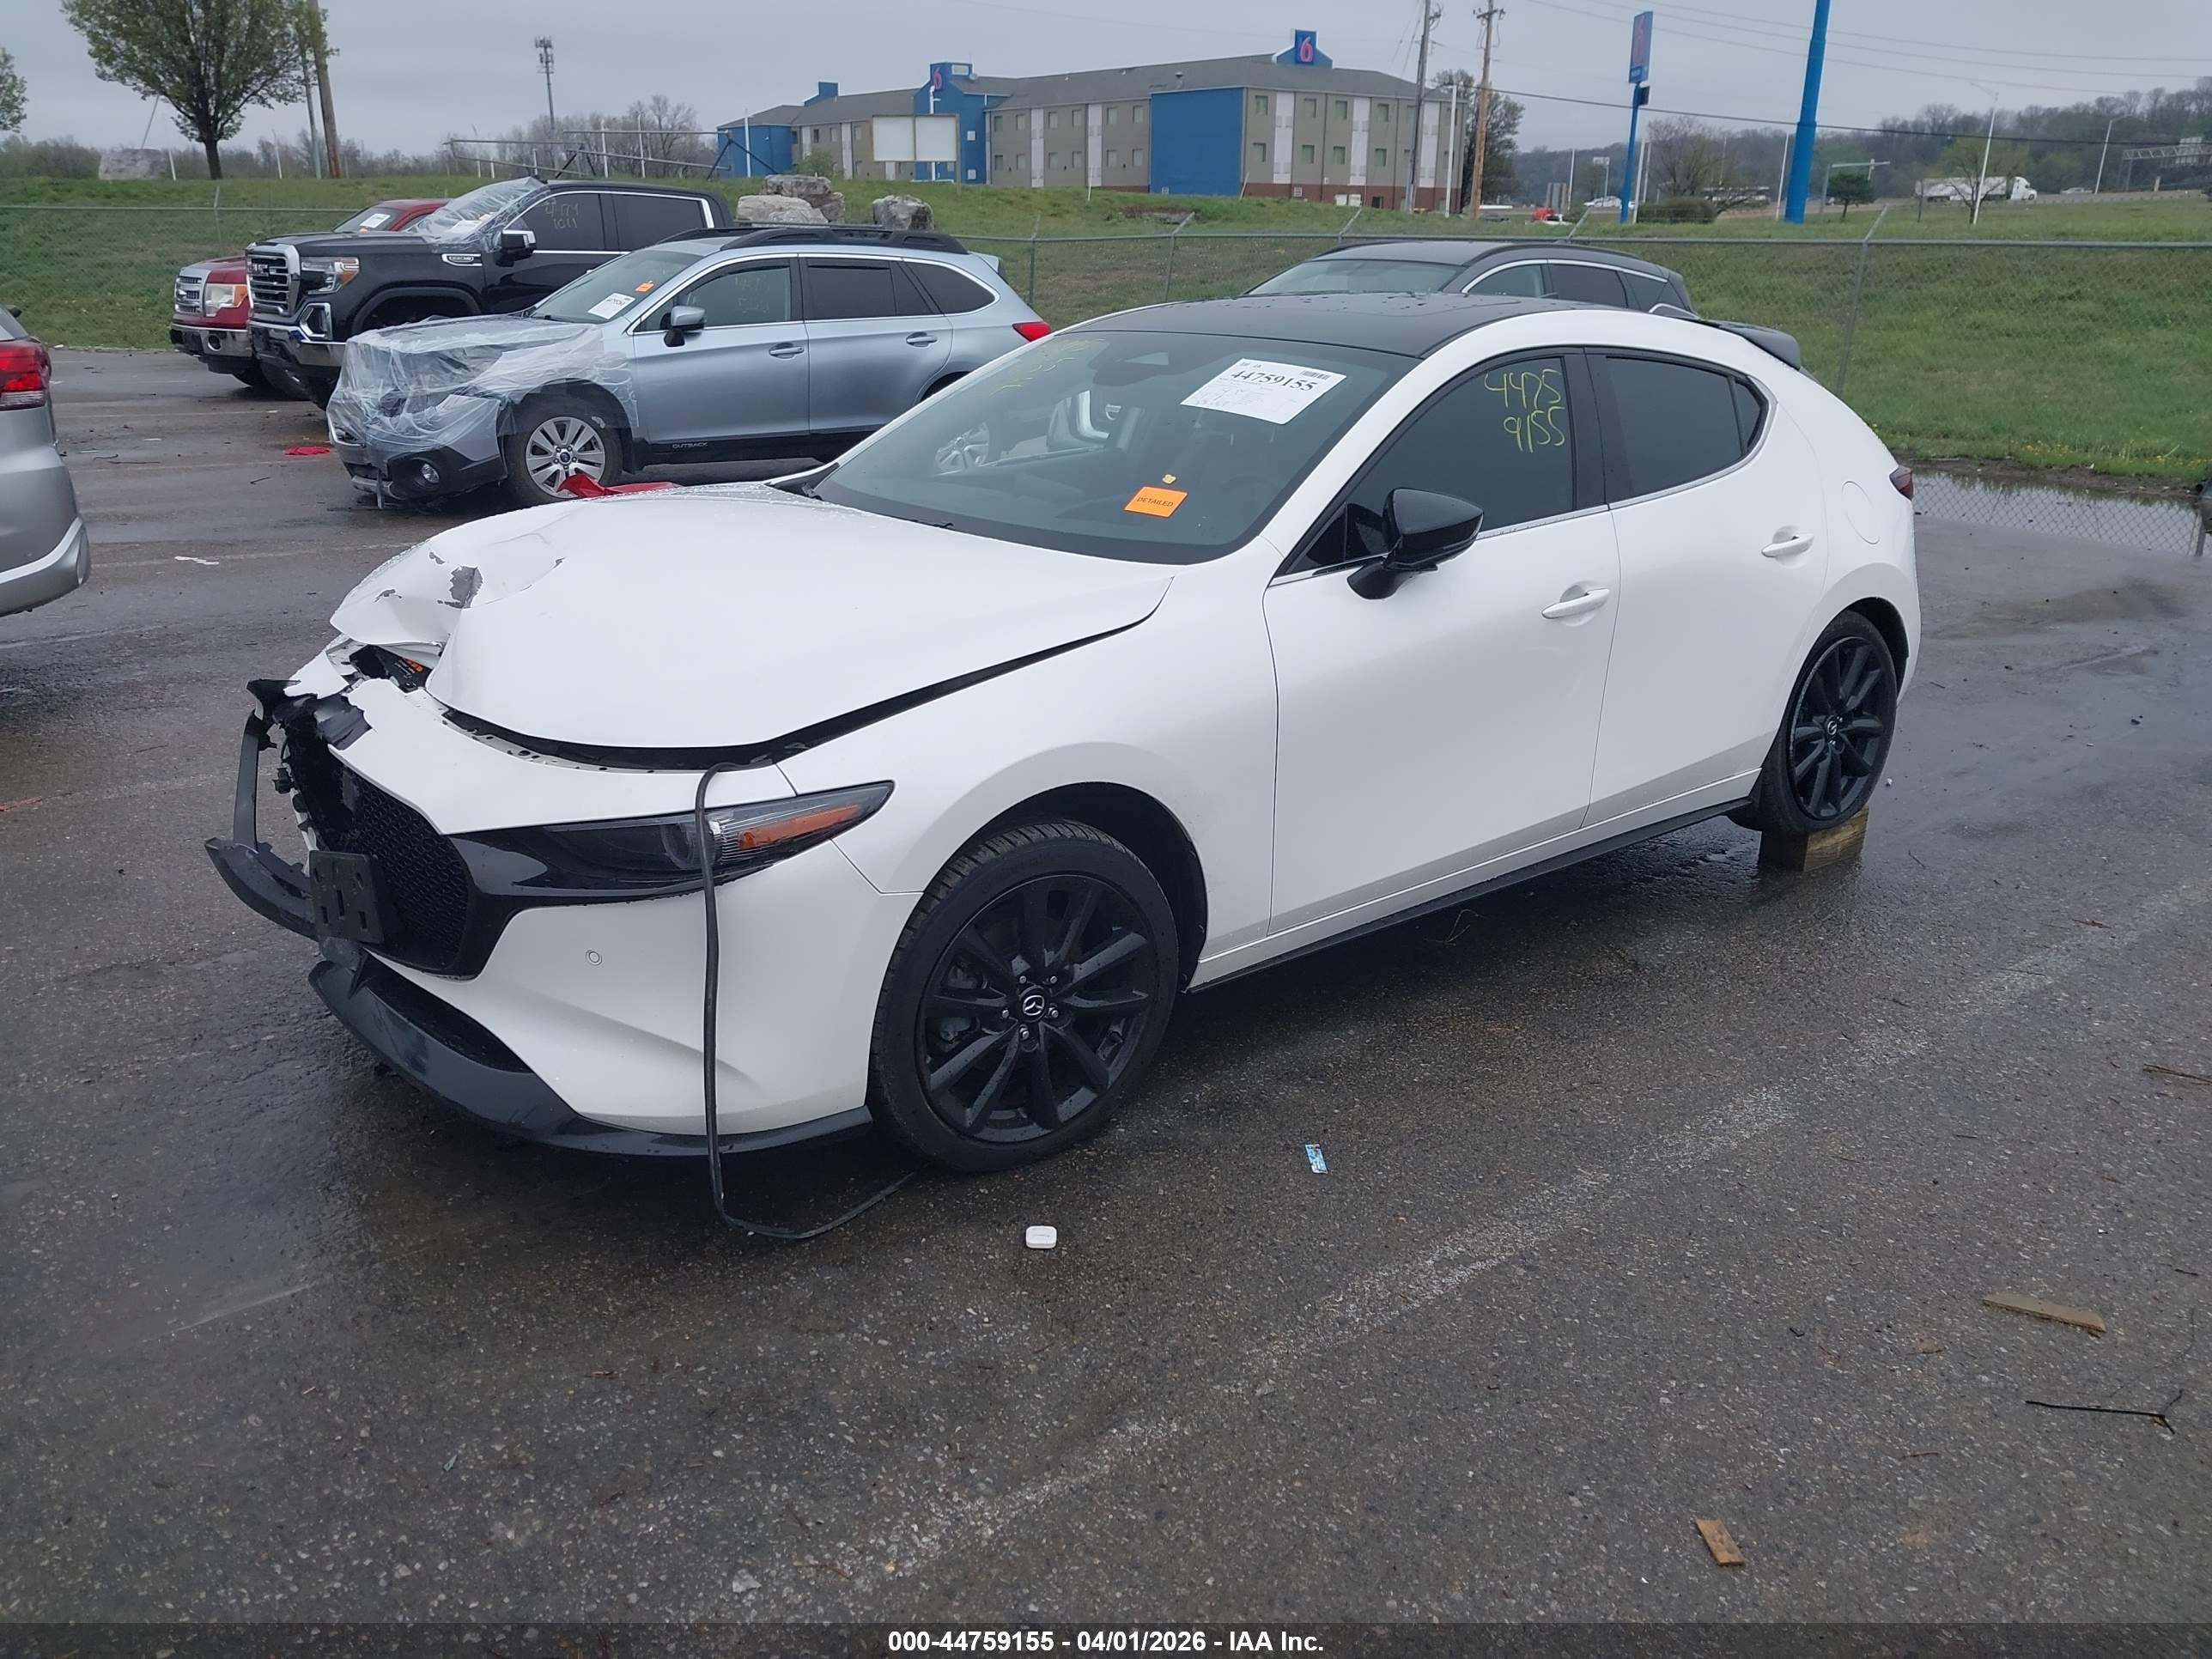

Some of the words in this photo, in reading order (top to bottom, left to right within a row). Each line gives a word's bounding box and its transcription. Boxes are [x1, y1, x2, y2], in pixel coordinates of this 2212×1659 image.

[1300, 36, 1313, 62] 6
[1231, 370, 1320, 392] 44759155
[1484, 368, 1562, 410] 4475
[1503, 405, 1565, 453] 9155
[1136, 496, 1174, 507] DETAILED
